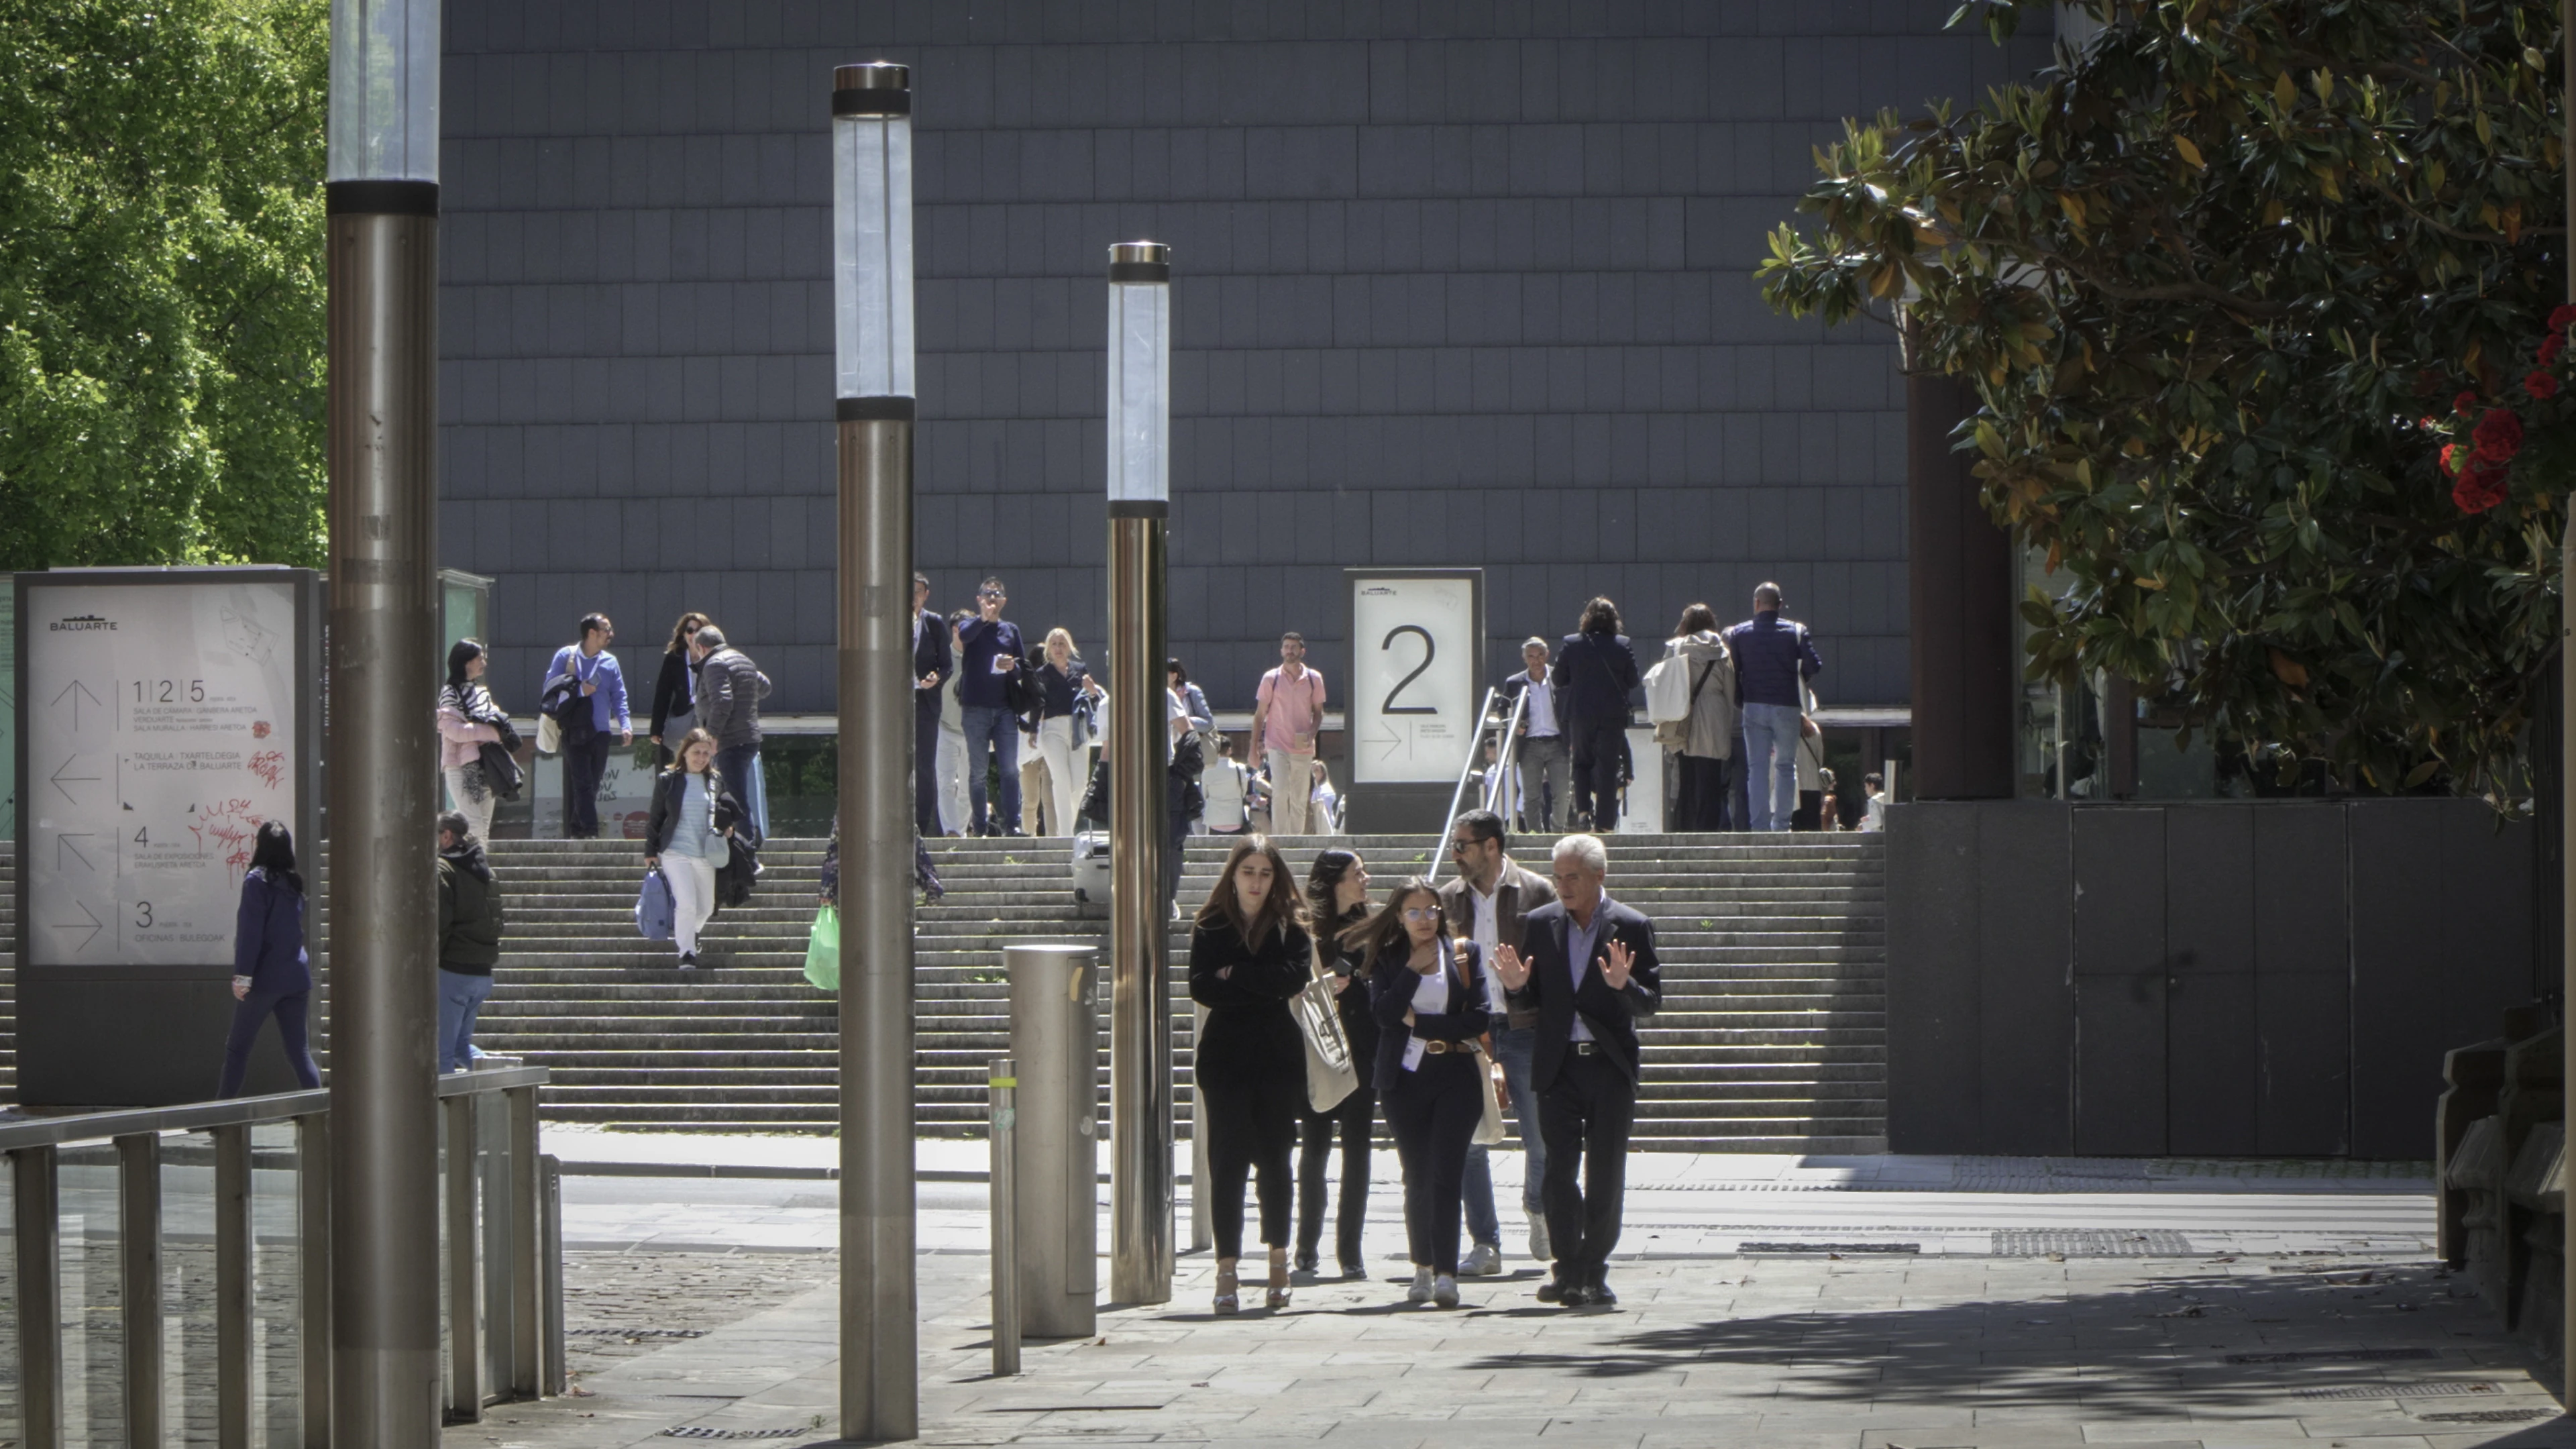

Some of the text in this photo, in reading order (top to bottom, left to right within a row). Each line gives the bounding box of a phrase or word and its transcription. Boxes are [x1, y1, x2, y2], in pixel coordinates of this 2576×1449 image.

[50, 622, 117, 631] BALUARTE
[1382, 625, 1438, 714] 2
[133, 680, 204, 702] 1 2 5
[134, 752, 241, 760] TAQUILLA TXARTELDEGIA
[147, 762, 184, 770] TERRAZA
[201, 762, 241, 770] BALUARTE
[134, 826, 148, 848] 4
[136, 902, 152, 928] 3
[135, 934, 225, 942] OFICINAS BULEGOAK
